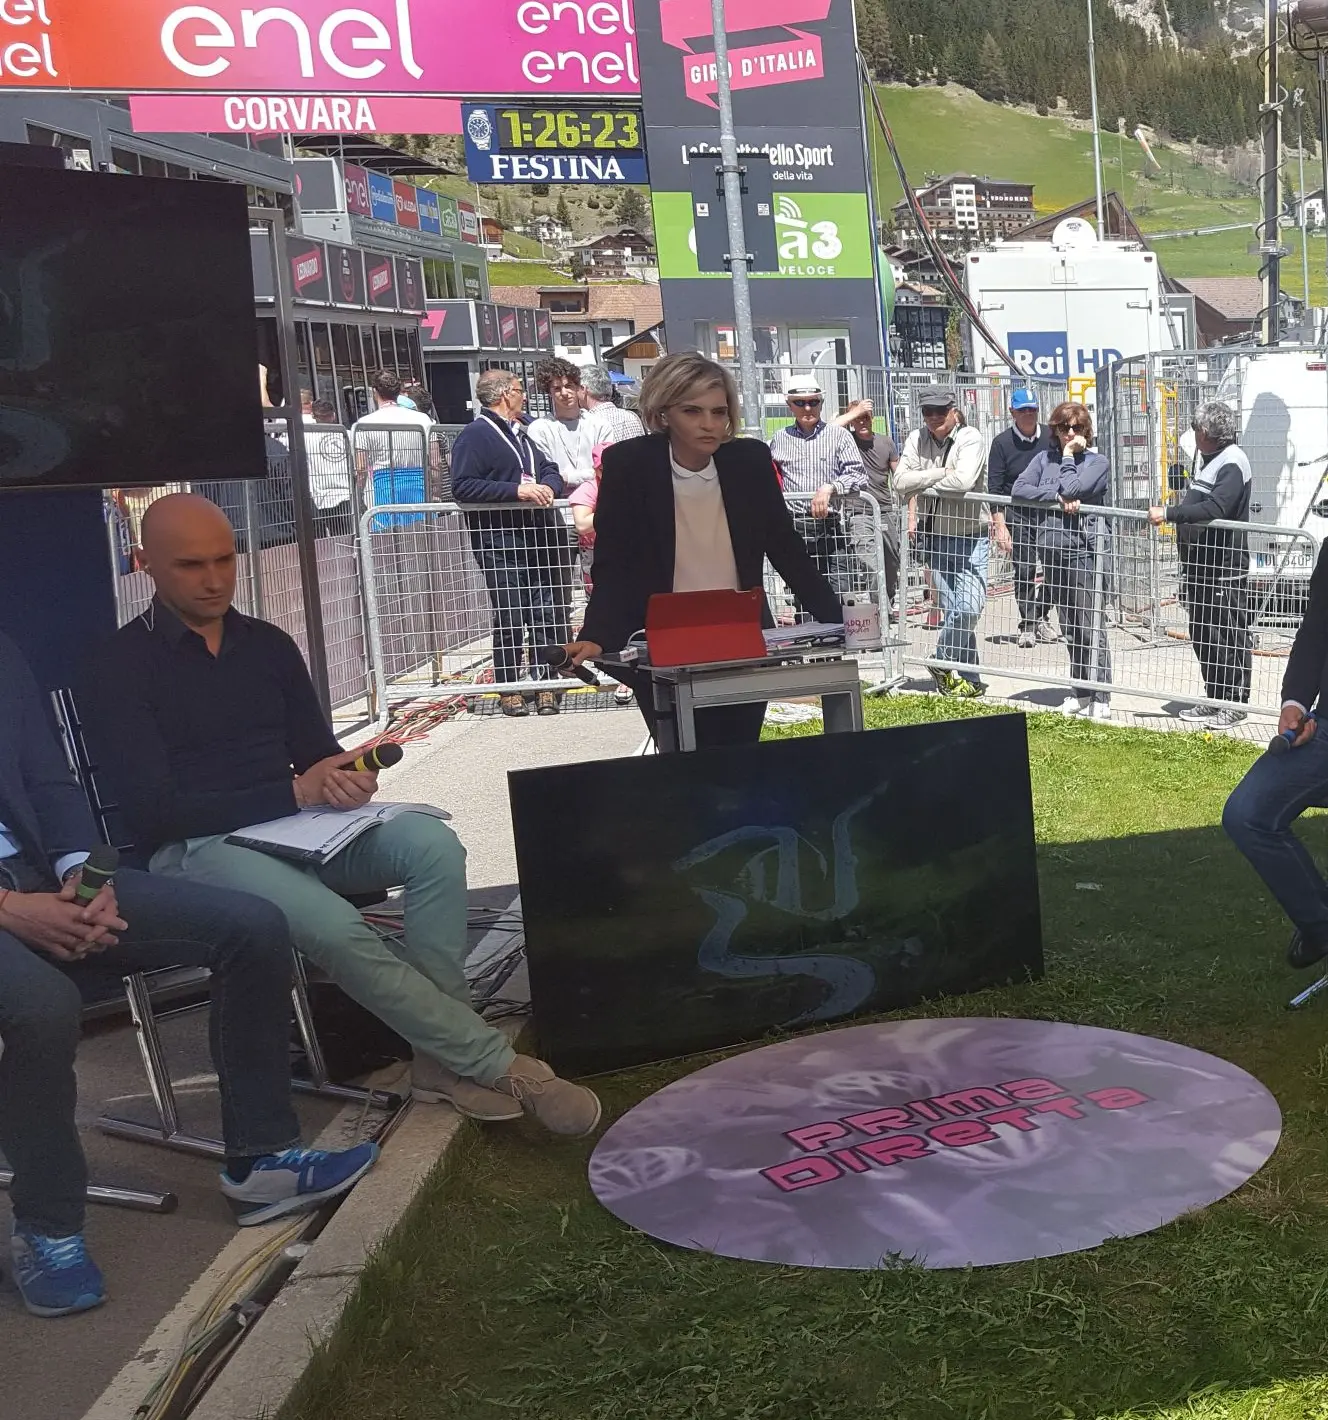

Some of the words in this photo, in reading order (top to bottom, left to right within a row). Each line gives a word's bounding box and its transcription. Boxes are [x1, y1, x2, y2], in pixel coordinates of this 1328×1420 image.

[0, 0, 52, 26] el
[517, 0, 635, 35] enel
[0, 32, 59, 78] el
[160, 0, 424, 80] enel
[522, 42, 639, 84] enel
[690, 62, 732, 84] GIR
[741, 49, 817, 77] D'ITALIA
[224, 96, 377, 131] CORVARA
[502, 109, 639, 149] 1:26:23
[490, 154, 625, 180] FESTINA
[795, 143, 834, 169] Sport
[772, 171, 795, 180] della
[796, 171, 813, 180] vita
[779, 265, 835, 275] VELOCE
[1013, 346, 1065, 375] Rai
[1077, 347, 1123, 375] HD
